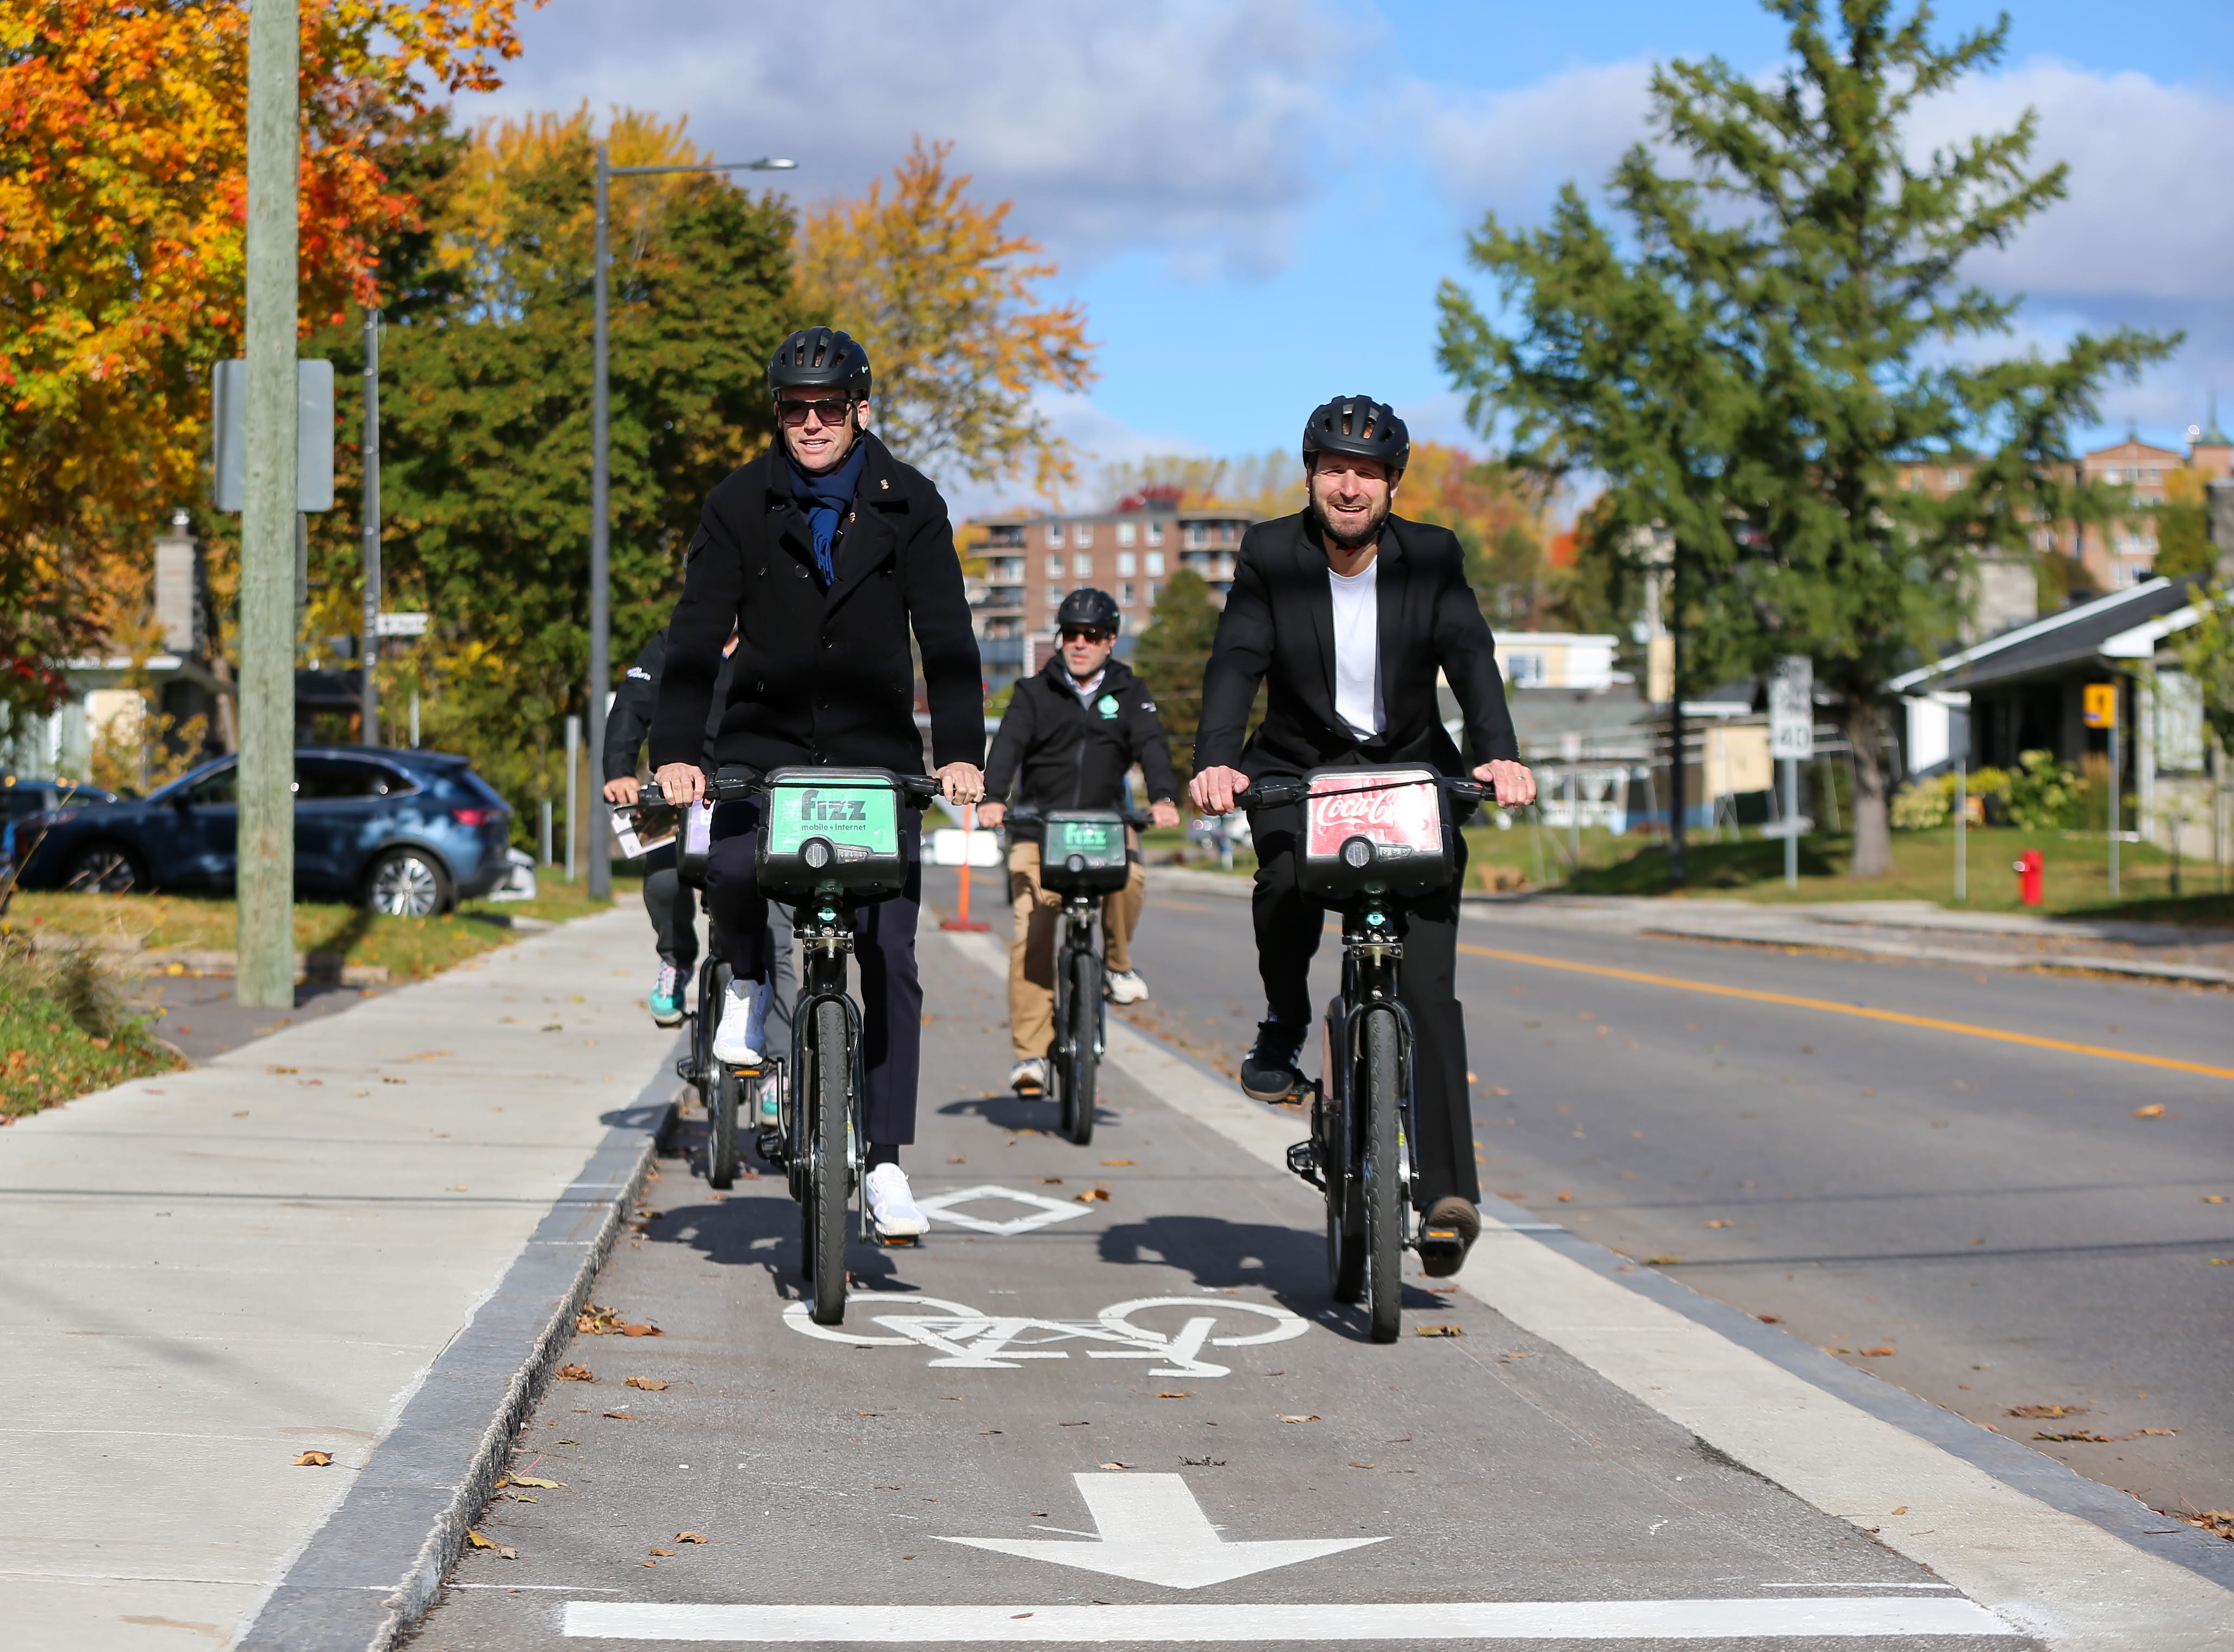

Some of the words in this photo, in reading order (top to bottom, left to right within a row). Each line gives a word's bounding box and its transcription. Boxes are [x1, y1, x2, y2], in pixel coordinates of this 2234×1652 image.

[1780, 725, 1809, 747] 40
[801, 789, 866, 821] fizz
[1318, 789, 1398, 826] Coca-Co
[801, 823, 828, 831] mobile
[835, 823, 866, 831] internet
[1064, 822, 1107, 844] fizz
